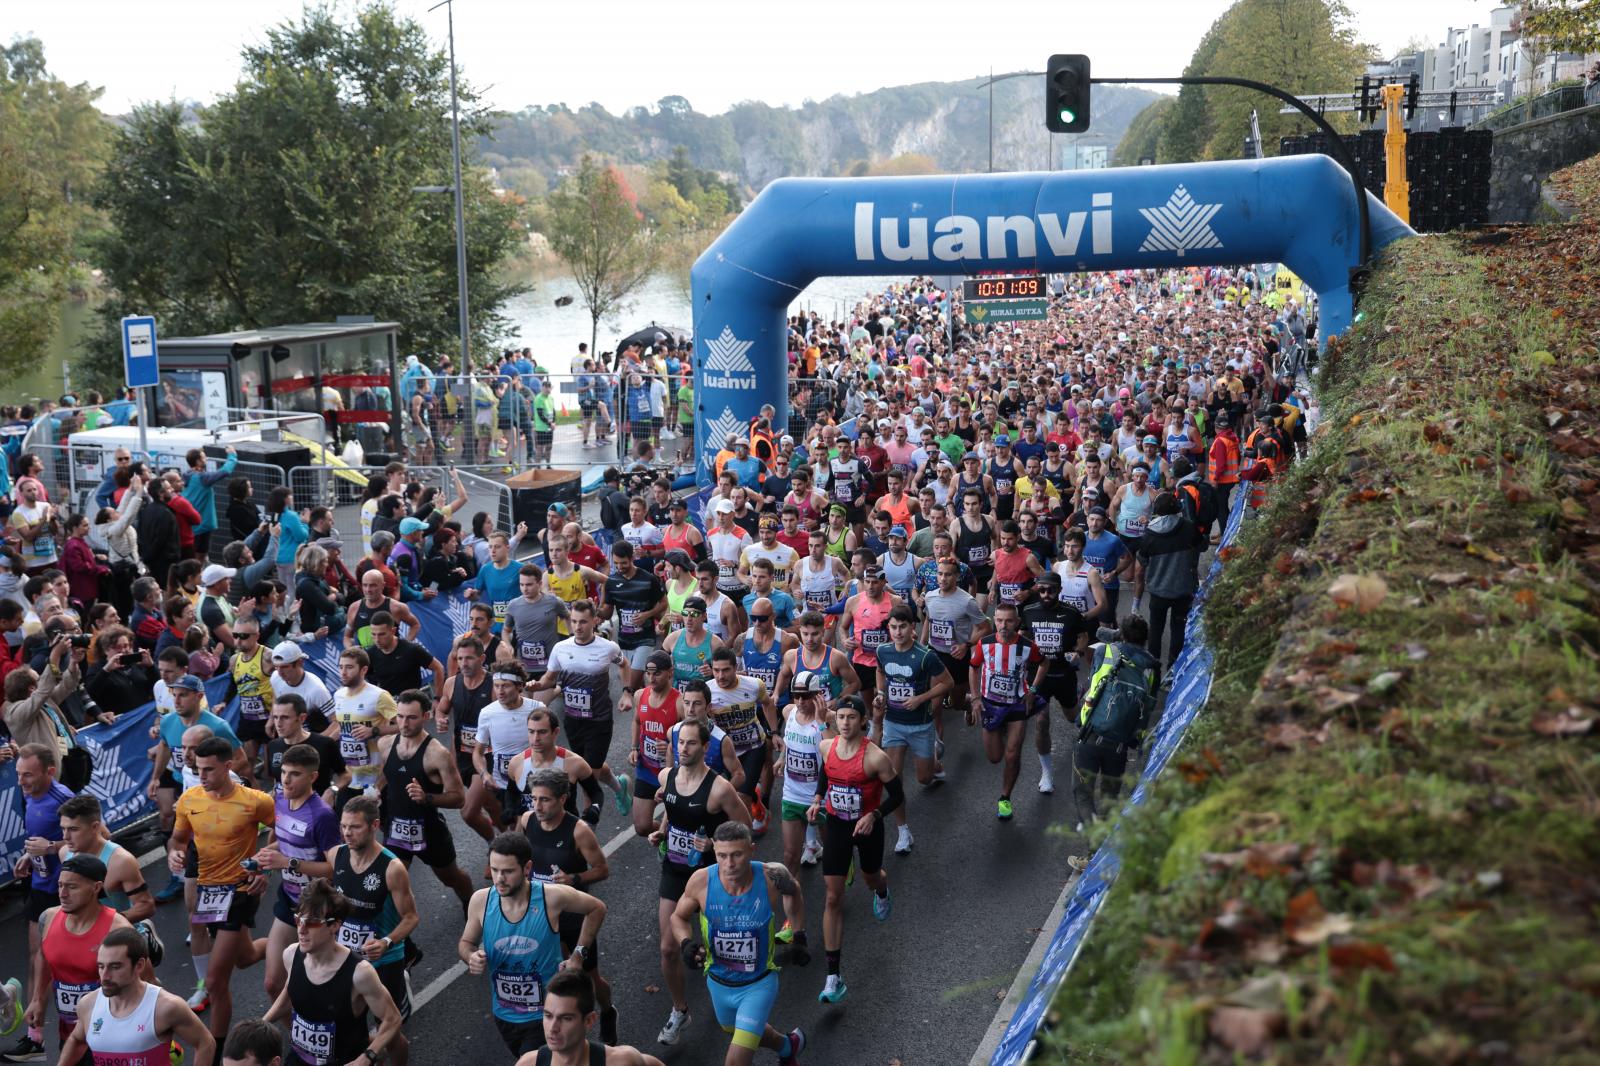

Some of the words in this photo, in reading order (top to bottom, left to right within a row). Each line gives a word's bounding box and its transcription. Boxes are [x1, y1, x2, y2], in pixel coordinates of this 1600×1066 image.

[855, 192, 1112, 261] luanvi
[978, 280, 1037, 297] 10:01:09
[1016, 308, 1042, 316] KUTXA
[704, 373, 756, 389] luanvi
[934, 625, 949, 634] 957
[866, 635, 885, 643] 895
[1036, 634, 1059, 642] 1059
[523, 647, 542, 655] 852
[567, 693, 586, 704] 911
[891, 688, 910, 697] 912
[645, 721, 664, 733] CUBA
[733, 731, 754, 742] 687
[786, 731, 817, 746] PORTUGAL
[343, 743, 363, 753] 934
[788, 756, 813, 769] 1119
[834, 793, 854, 805] 511
[104, 791, 146, 823] anvi
[395, 823, 418, 836] 656
[671, 834, 695, 850] 765
[203, 892, 228, 905] 877
[342, 929, 370, 945] 997
[717, 930, 743, 939] luanvi
[717, 939, 754, 954] 1271
[498, 973, 523, 982] luanvi
[59, 982, 81, 991] luanvi
[501, 983, 535, 996] 682
[61, 992, 84, 1006] 87
[296, 1014, 315, 1030] luanvi
[294, 1025, 328, 1047] 1149
[310, 1046, 328, 1055] SANZ
